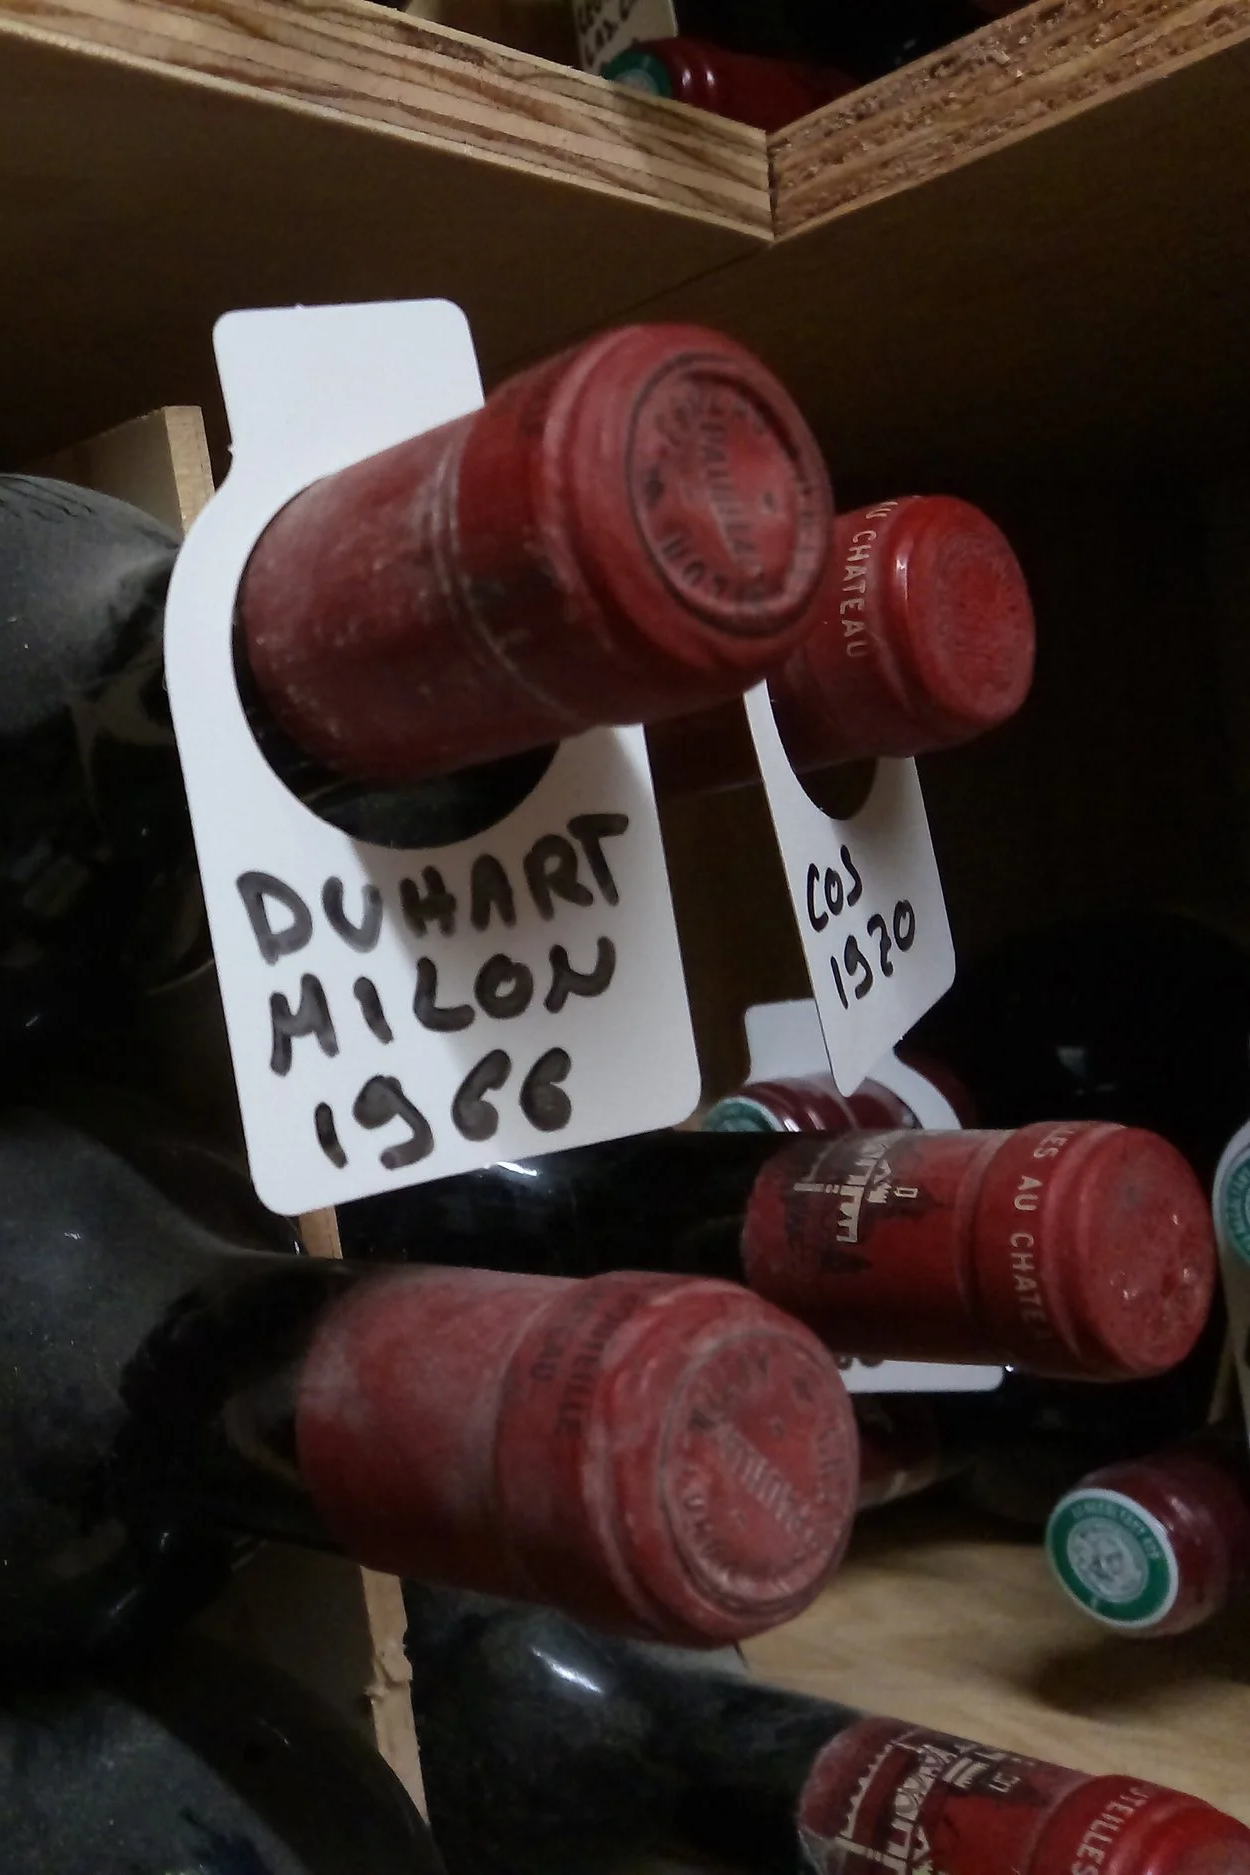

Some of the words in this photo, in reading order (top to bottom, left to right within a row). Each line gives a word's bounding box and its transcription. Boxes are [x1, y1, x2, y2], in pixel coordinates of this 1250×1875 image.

[839, 529, 877, 659] CHATEAU
[236, 813, 630, 966] DUHART
[806, 844, 863, 933] COS
[269, 936, 617, 1077] MILON
[314, 1046, 572, 1170] 1966
[1013, 1174, 1043, 1212] AU
